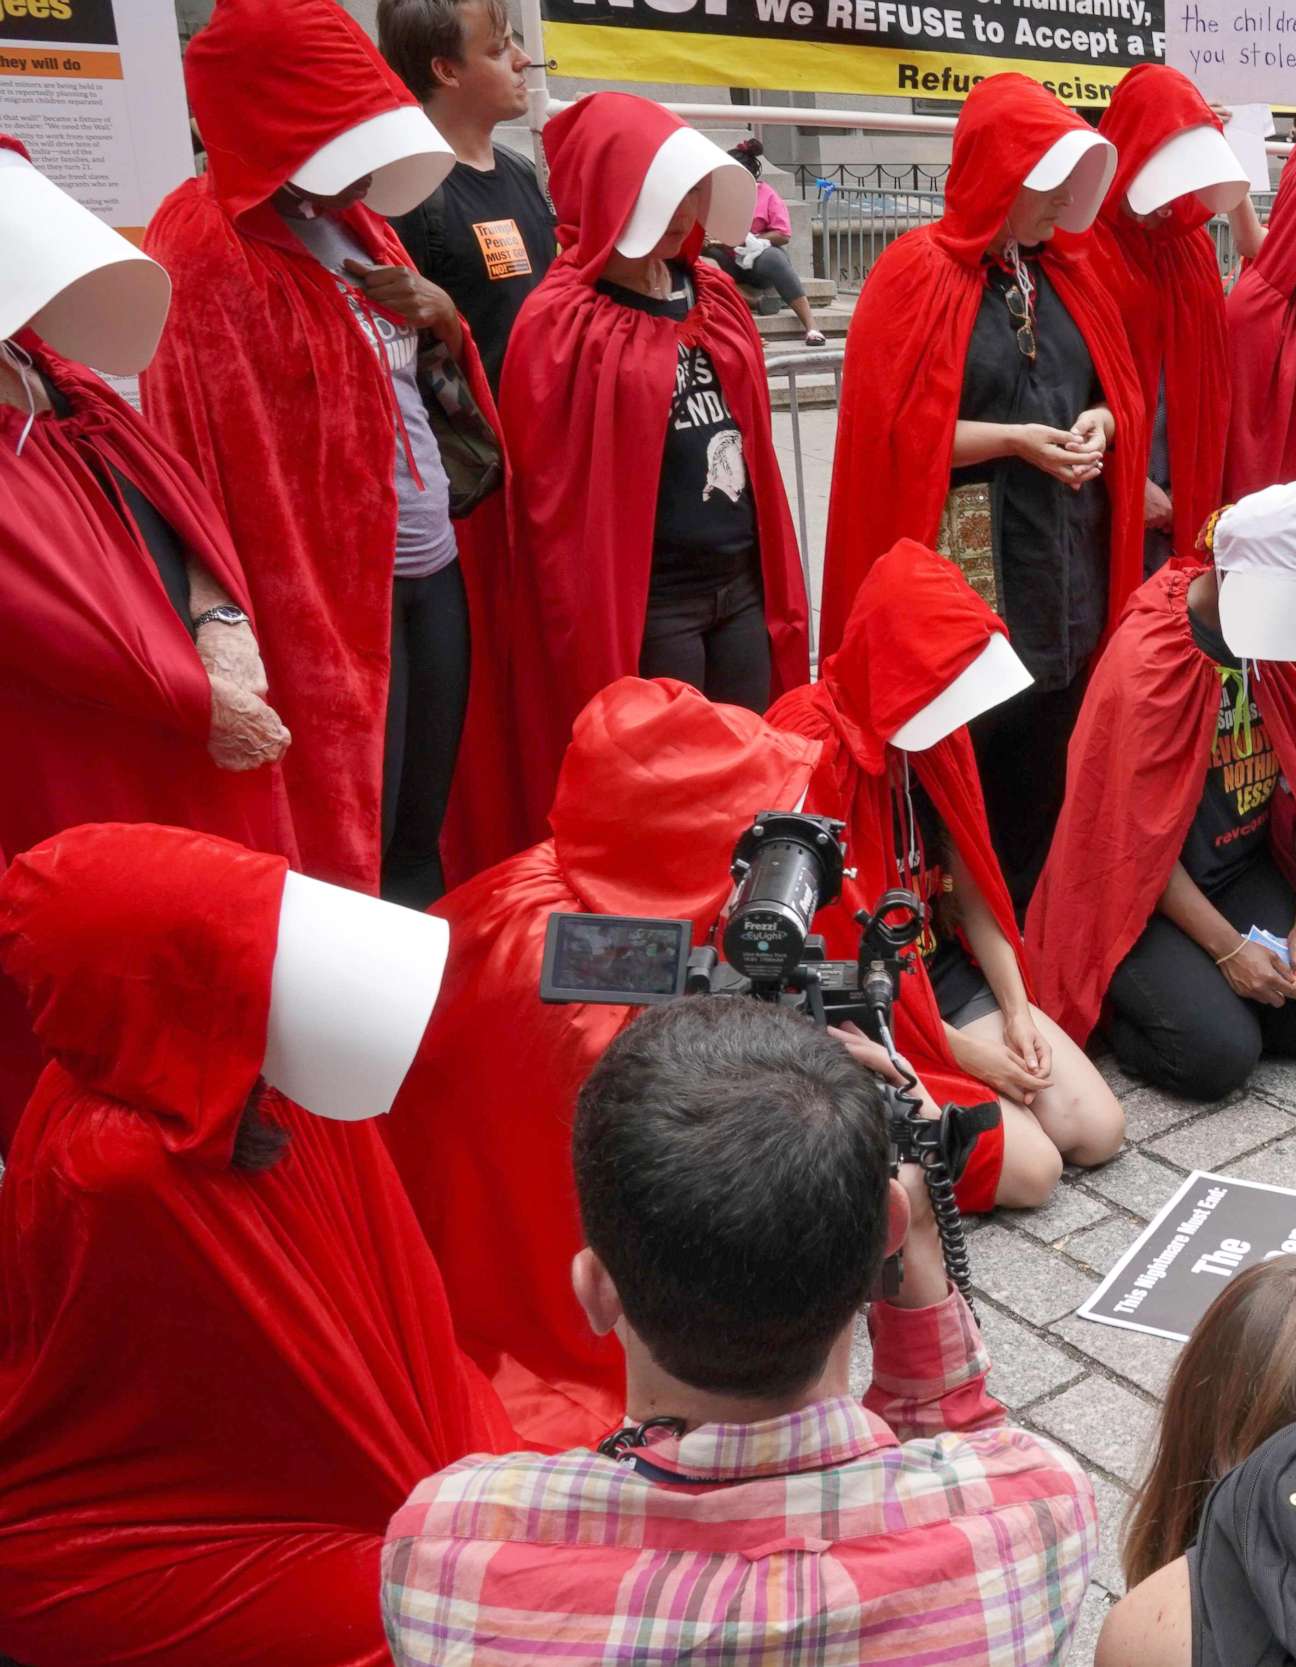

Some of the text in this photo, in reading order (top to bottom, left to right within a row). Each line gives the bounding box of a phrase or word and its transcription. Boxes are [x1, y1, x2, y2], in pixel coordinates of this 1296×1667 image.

[755, 0, 814, 25] We
[827, 1, 965, 40] REFUSE
[972, 14, 1005, 43] to
[1014, 17, 1109, 58] Accept
[1127, 35, 1145, 55] a
[1182, 5, 1219, 33] the
[32, 58, 59, 70] will
[63, 60, 81, 71] do
[1189, 49, 1226, 73] you
[744, 921, 778, 931] Frezzi
[1113, 1187, 1228, 1313] This Nightmare Must End:
[1191, 1238, 1251, 1277] The
